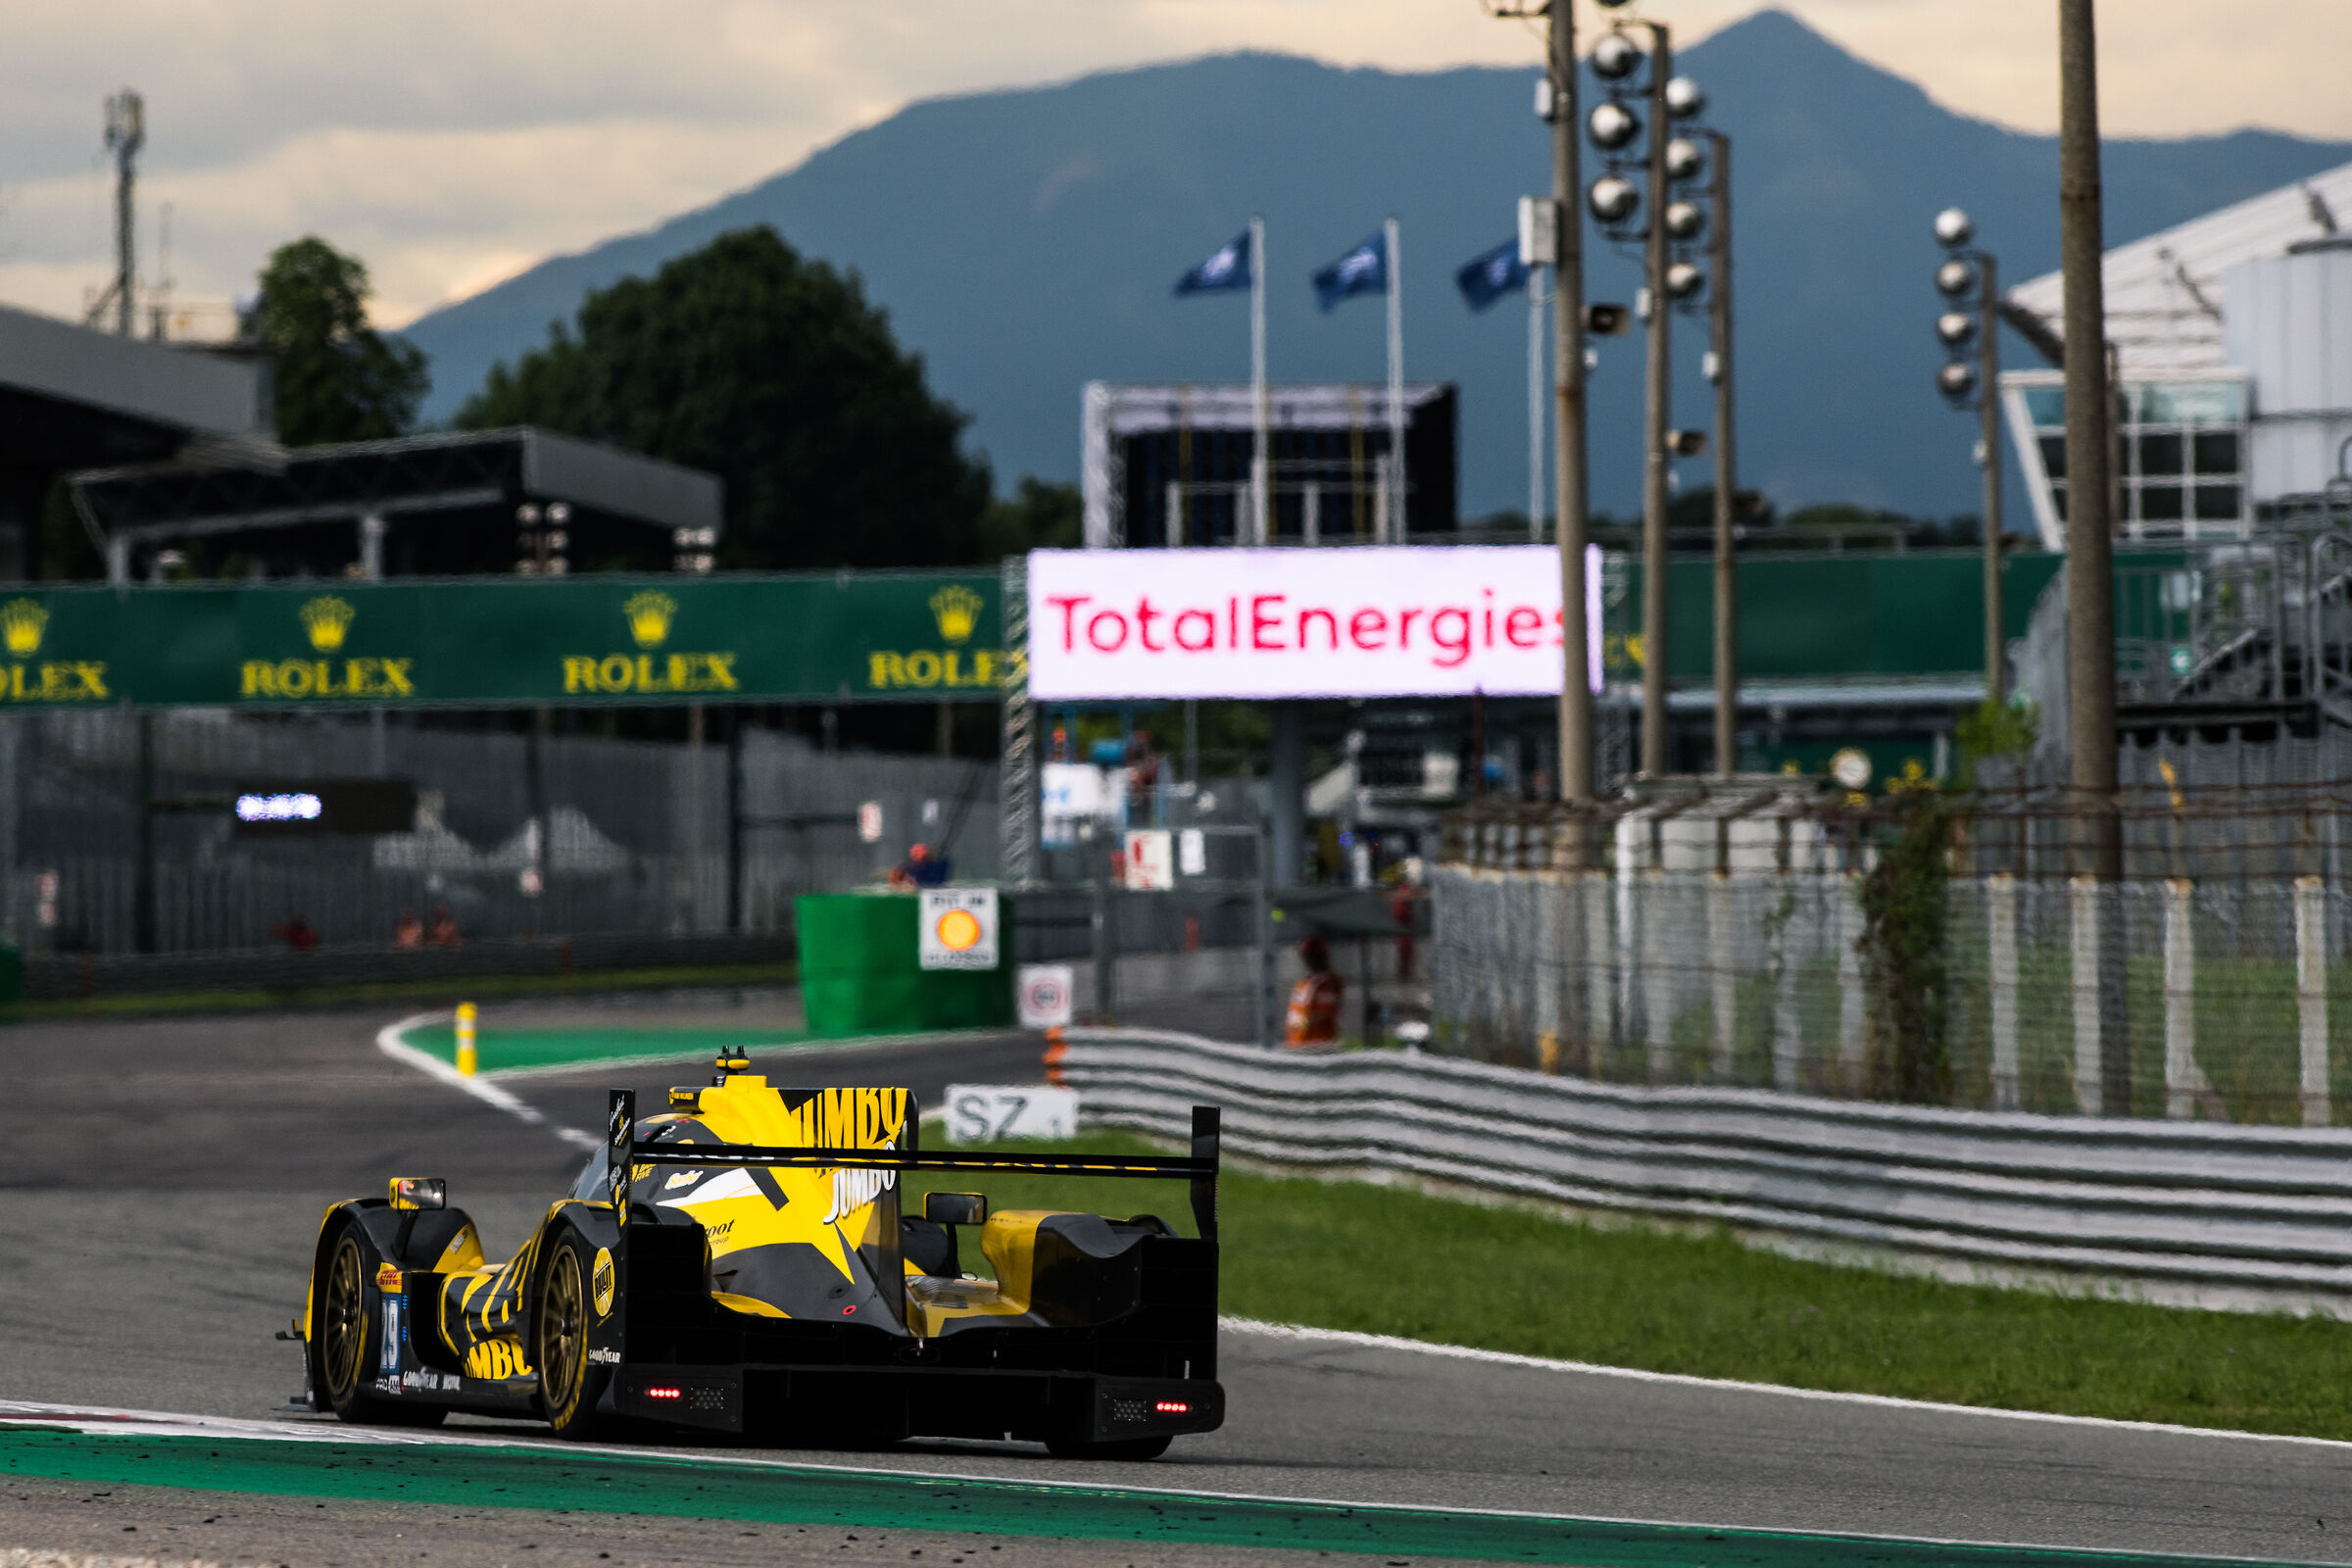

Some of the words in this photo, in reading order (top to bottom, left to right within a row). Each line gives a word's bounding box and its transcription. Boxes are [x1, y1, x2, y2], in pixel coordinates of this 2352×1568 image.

[0, 661, 110, 702] LEX
[240, 658, 416, 698] ROLEX
[562, 652, 739, 693] ROLEX
[956, 1095, 1028, 1140] SZ
[589, 1347, 621, 1364] GOODYEAR
